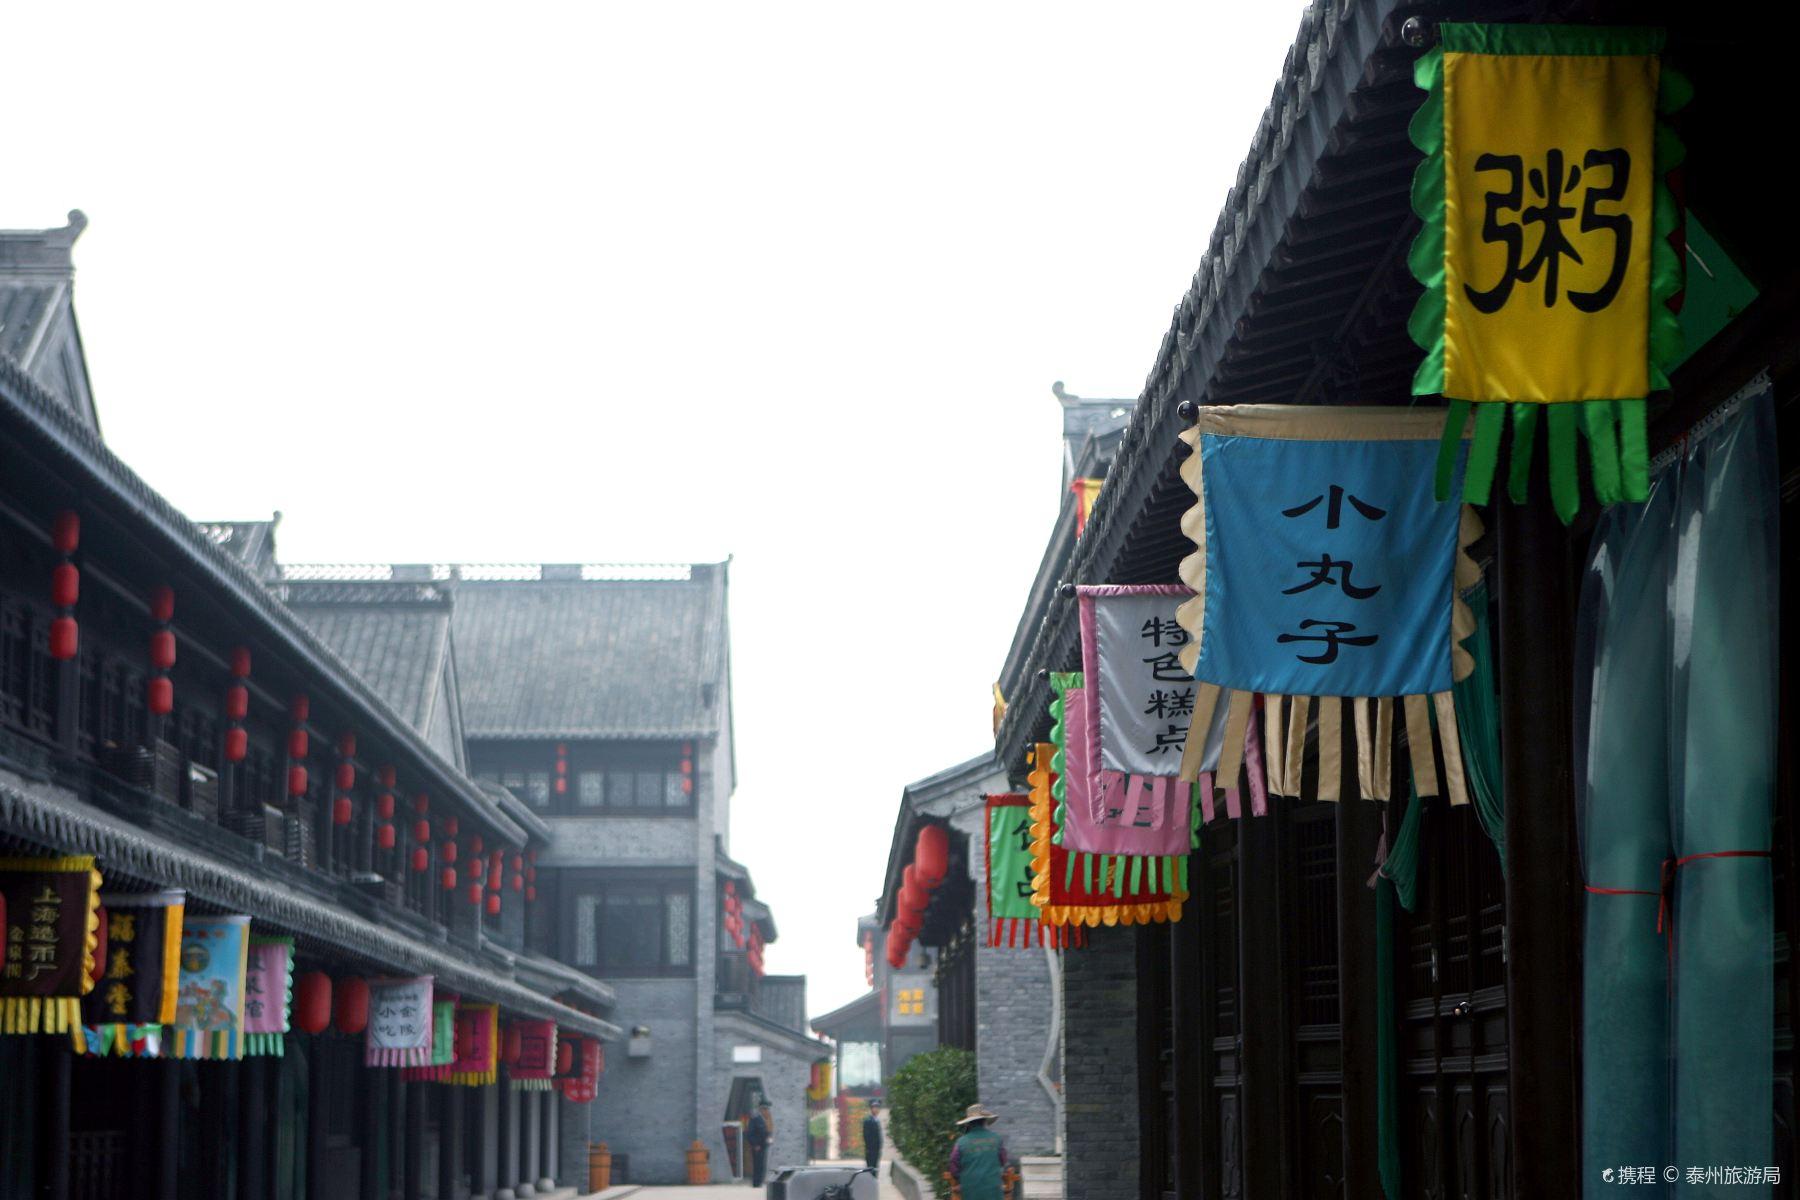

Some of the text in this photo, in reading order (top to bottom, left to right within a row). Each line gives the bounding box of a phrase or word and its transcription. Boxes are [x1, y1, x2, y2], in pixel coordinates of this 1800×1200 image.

[1463, 147, 1633, 314] 粥
[1276, 484, 1387, 665] 小丸子
[1141, 616, 1196, 755] 特色糕点
